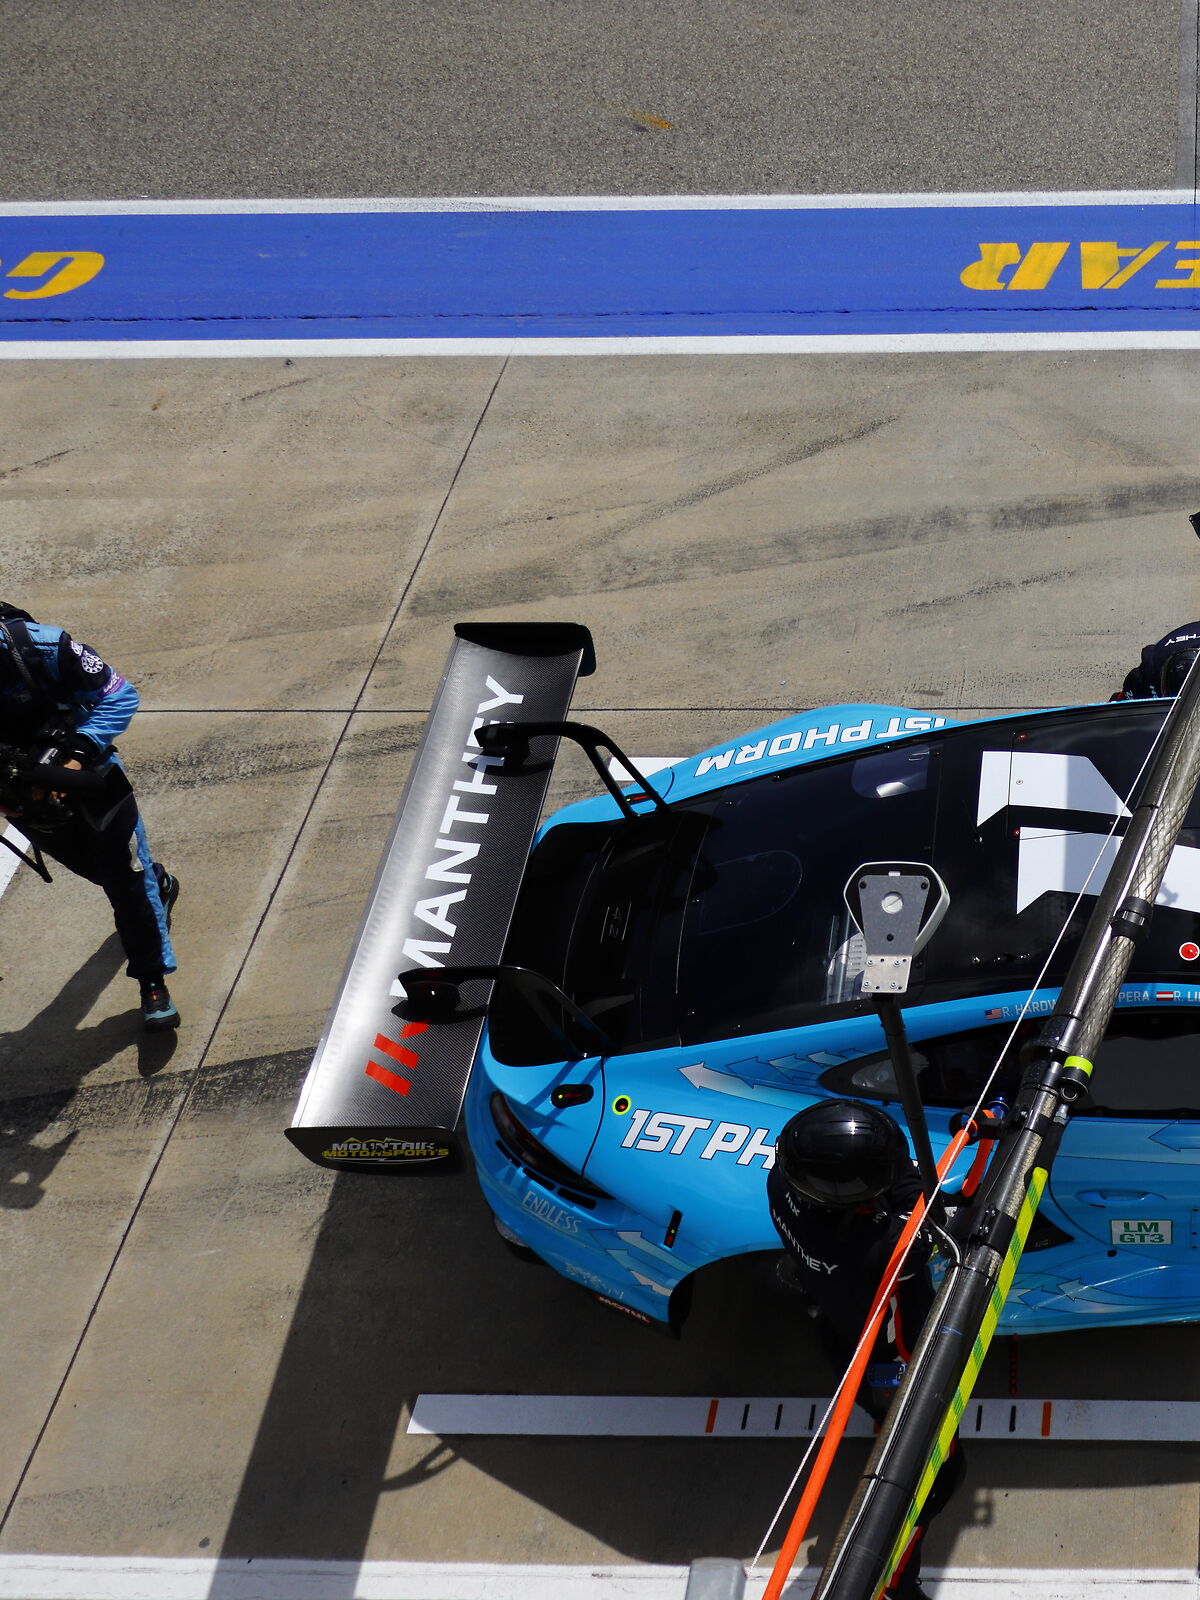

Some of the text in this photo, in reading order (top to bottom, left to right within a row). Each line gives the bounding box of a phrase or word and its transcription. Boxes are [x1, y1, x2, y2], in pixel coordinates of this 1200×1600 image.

[694, 719, 873, 777] PHORM
[1118, 991, 1150, 1003] PERA
[1173, 990, 1185, 1001] R.
[620, 1109, 776, 1170] 1ST PH
[521, 1191, 582, 1233] ENDLESS
[1119, 1233, 1165, 1243] GT3
[1123, 1222, 1159, 1233] LM
[775, 1212, 839, 1275] MANTHEY
